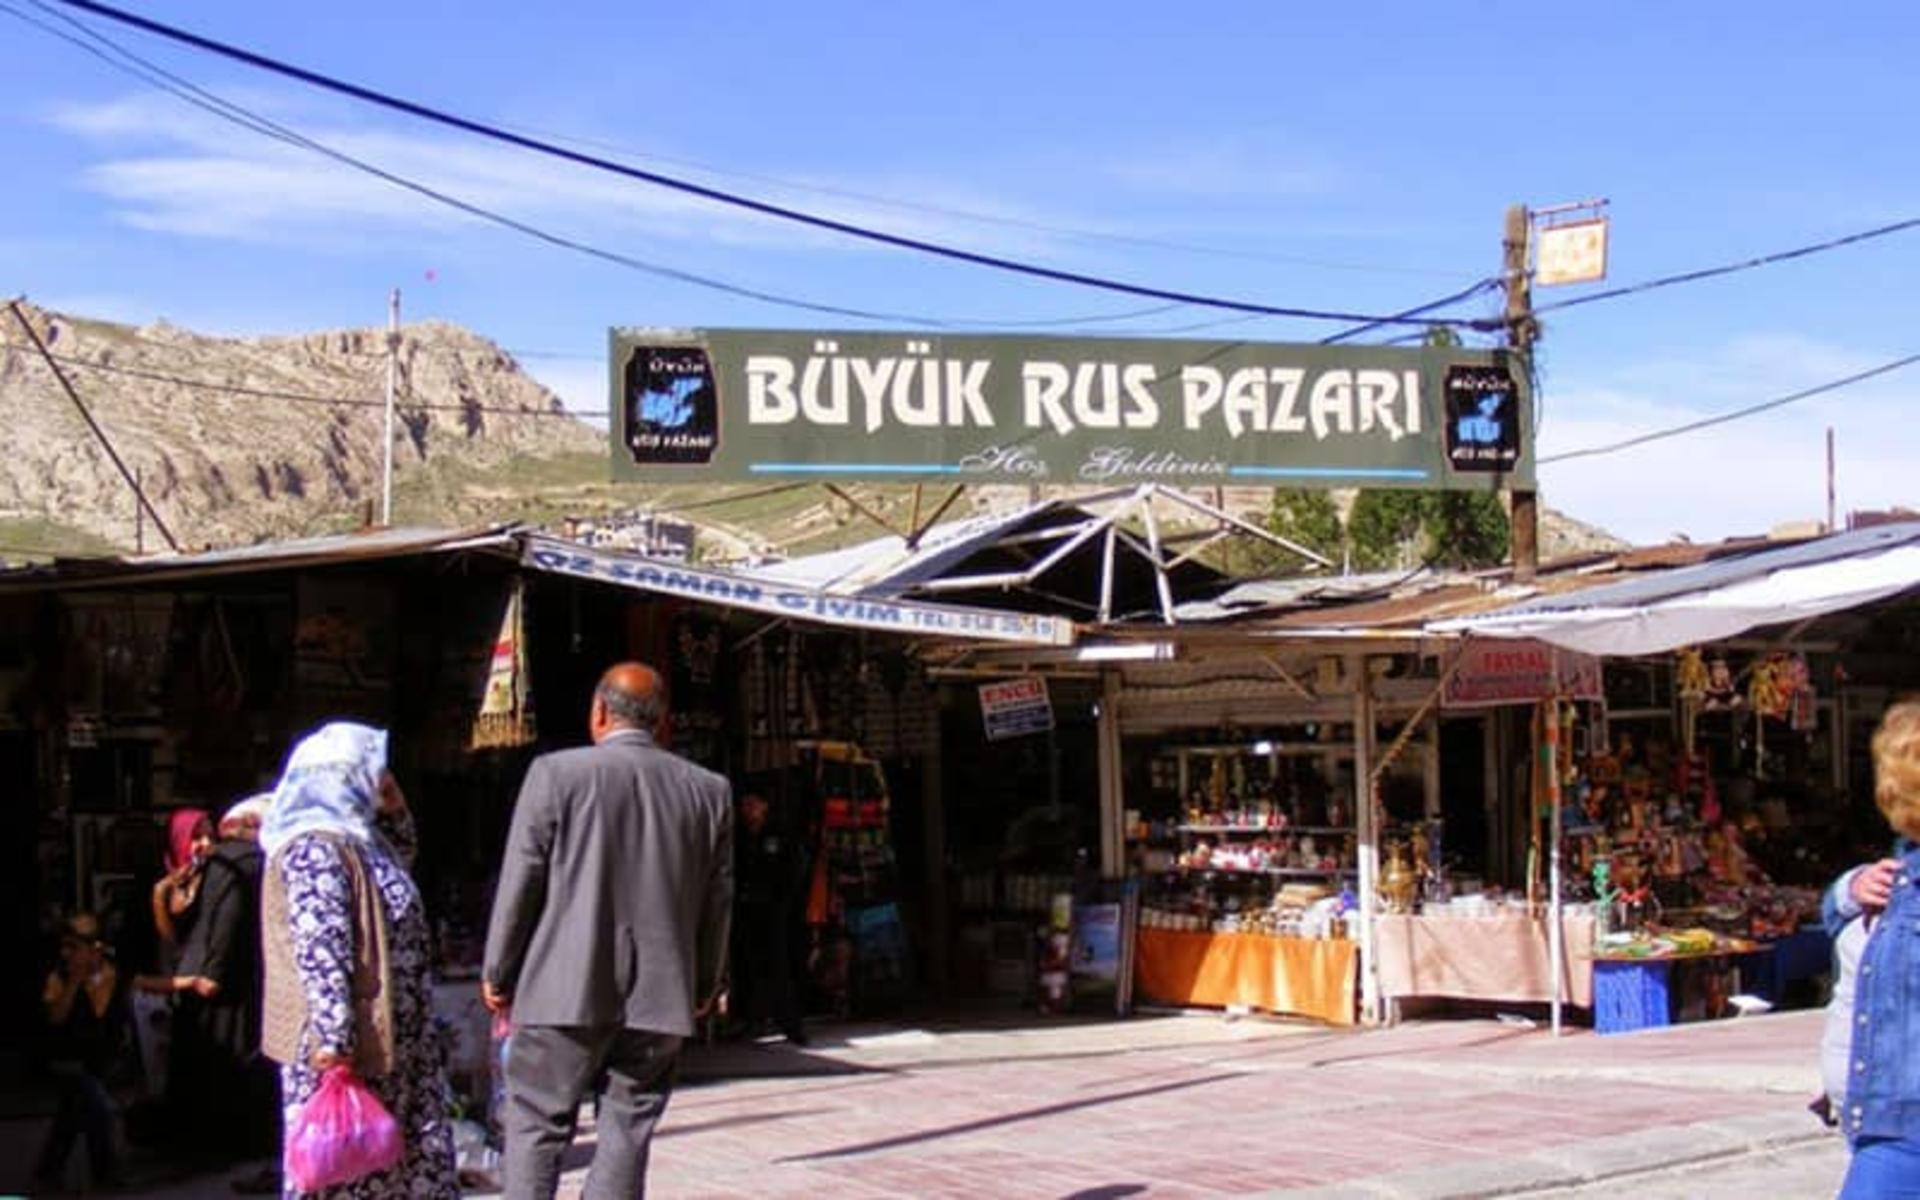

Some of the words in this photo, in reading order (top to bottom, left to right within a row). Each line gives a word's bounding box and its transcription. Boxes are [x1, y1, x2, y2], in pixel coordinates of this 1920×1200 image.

[745, 340, 996, 433] BÜYÜK
[1022, 361, 1160, 435] RUS
[1181, 365, 1422, 442] PAZARI
[609, 563, 763, 602] SAMAN
